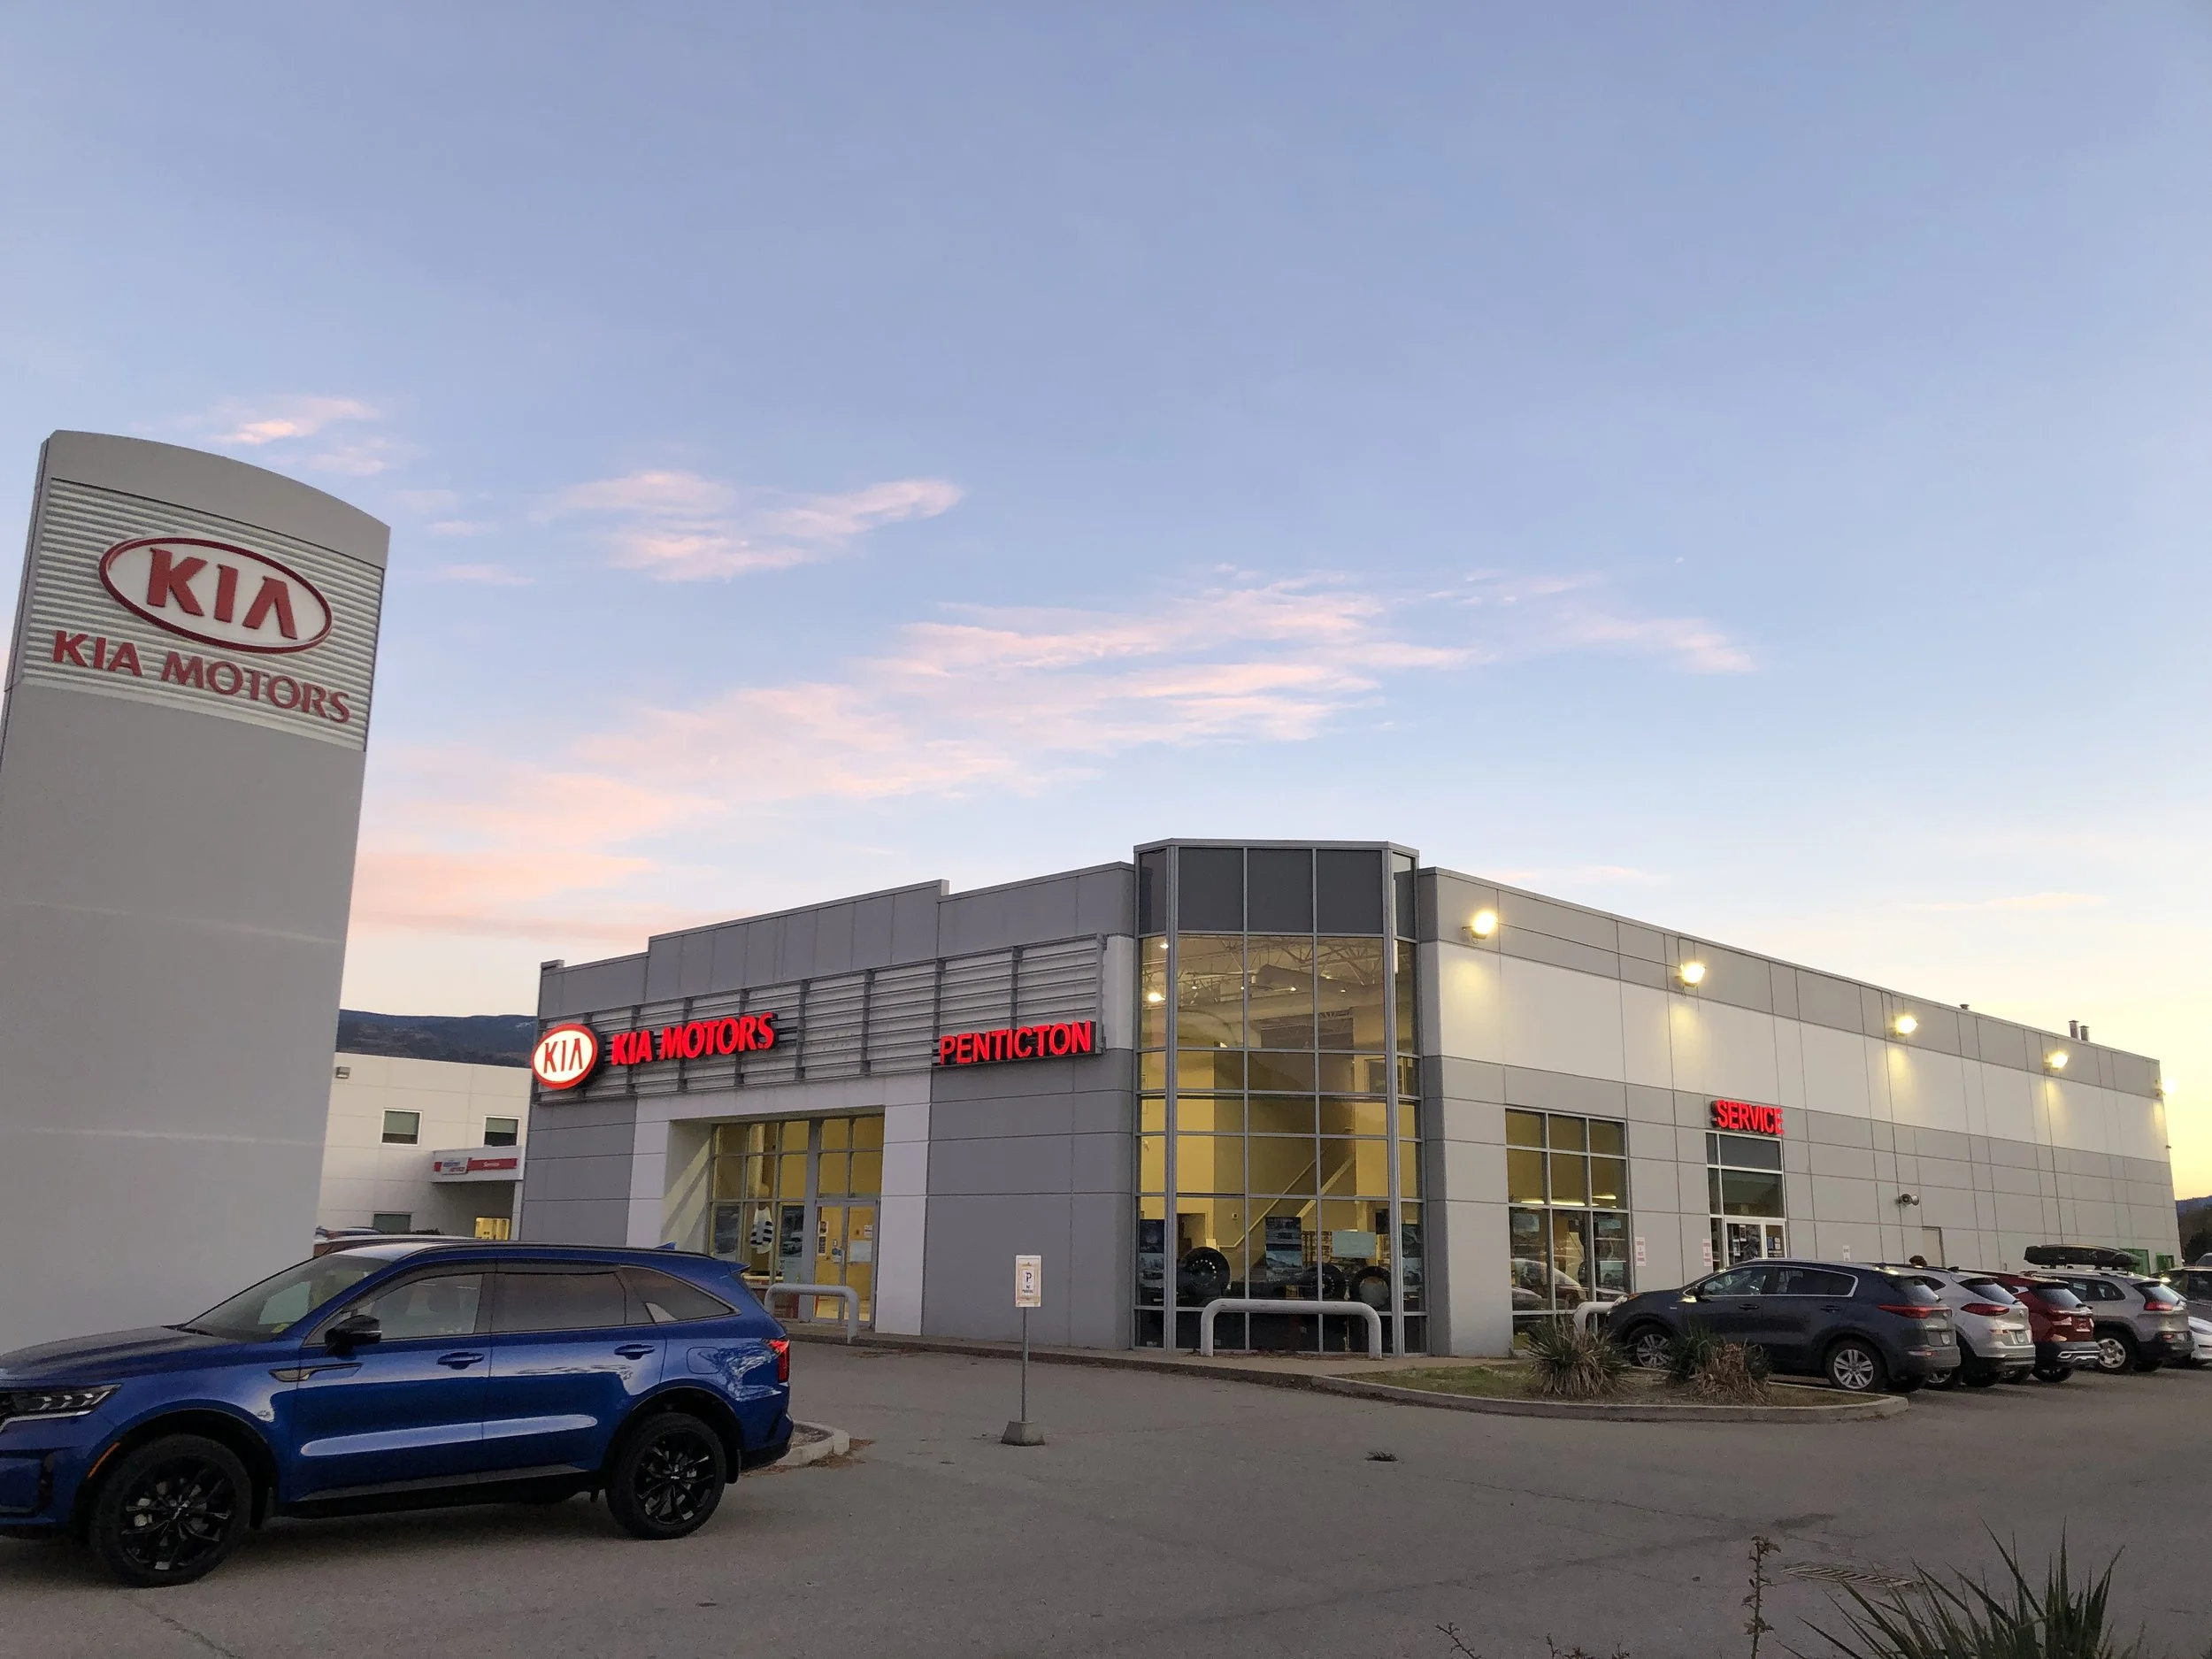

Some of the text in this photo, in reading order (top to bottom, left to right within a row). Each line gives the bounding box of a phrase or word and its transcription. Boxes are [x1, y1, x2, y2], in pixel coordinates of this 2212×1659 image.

[147, 547, 297, 640] KIA
[52, 630, 351, 724] KIA MOTORS
[543, 1037, 584, 1074] KIA
[611, 1011, 776, 1066] KIA MOTORS
[940, 1020, 1092, 1065] PENTICTON
[1716, 1098, 1784, 1134] SERVICE
